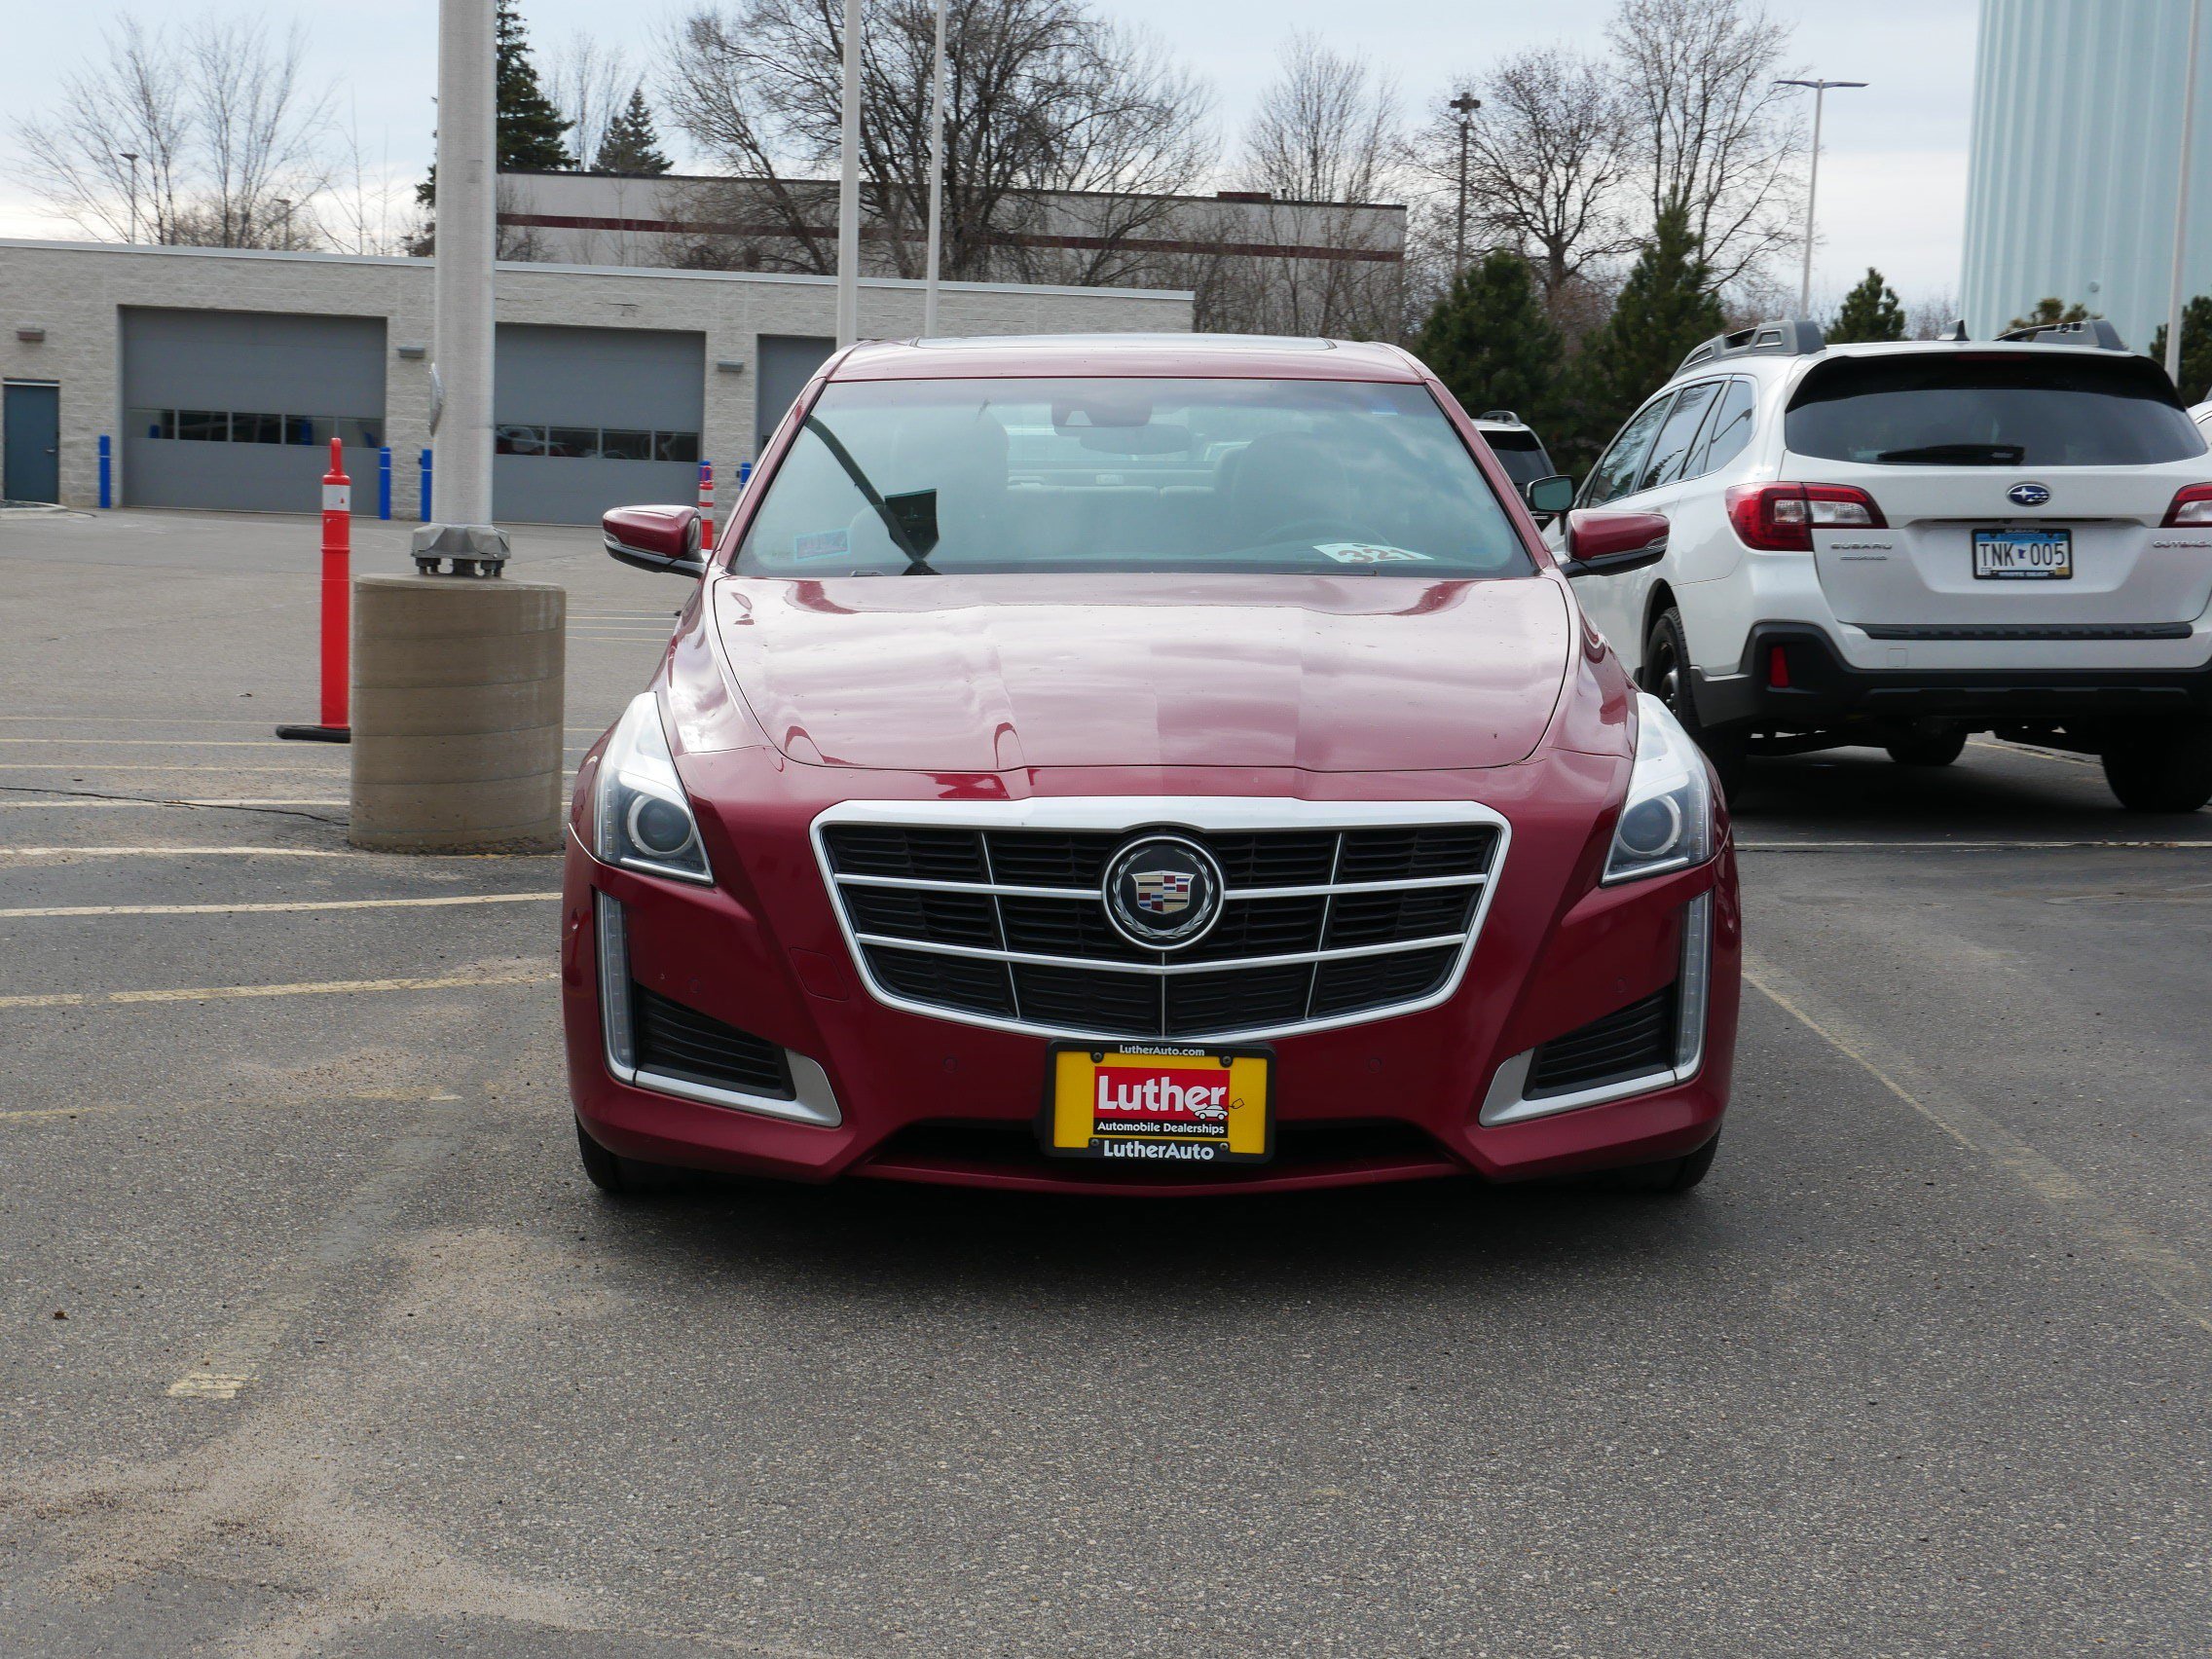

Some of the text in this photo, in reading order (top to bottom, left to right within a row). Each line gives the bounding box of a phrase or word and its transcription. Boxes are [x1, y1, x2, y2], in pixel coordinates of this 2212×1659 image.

[1978, 542, 2065, 567] TNK 005
[1119, 1044, 1205, 1057] LutherAuto.com
[1097, 1074, 1228, 1113] Luther
[1096, 1121, 1226, 1135] Automobile Dealerships
[1103, 1139, 1215, 1161] LutherAuto
